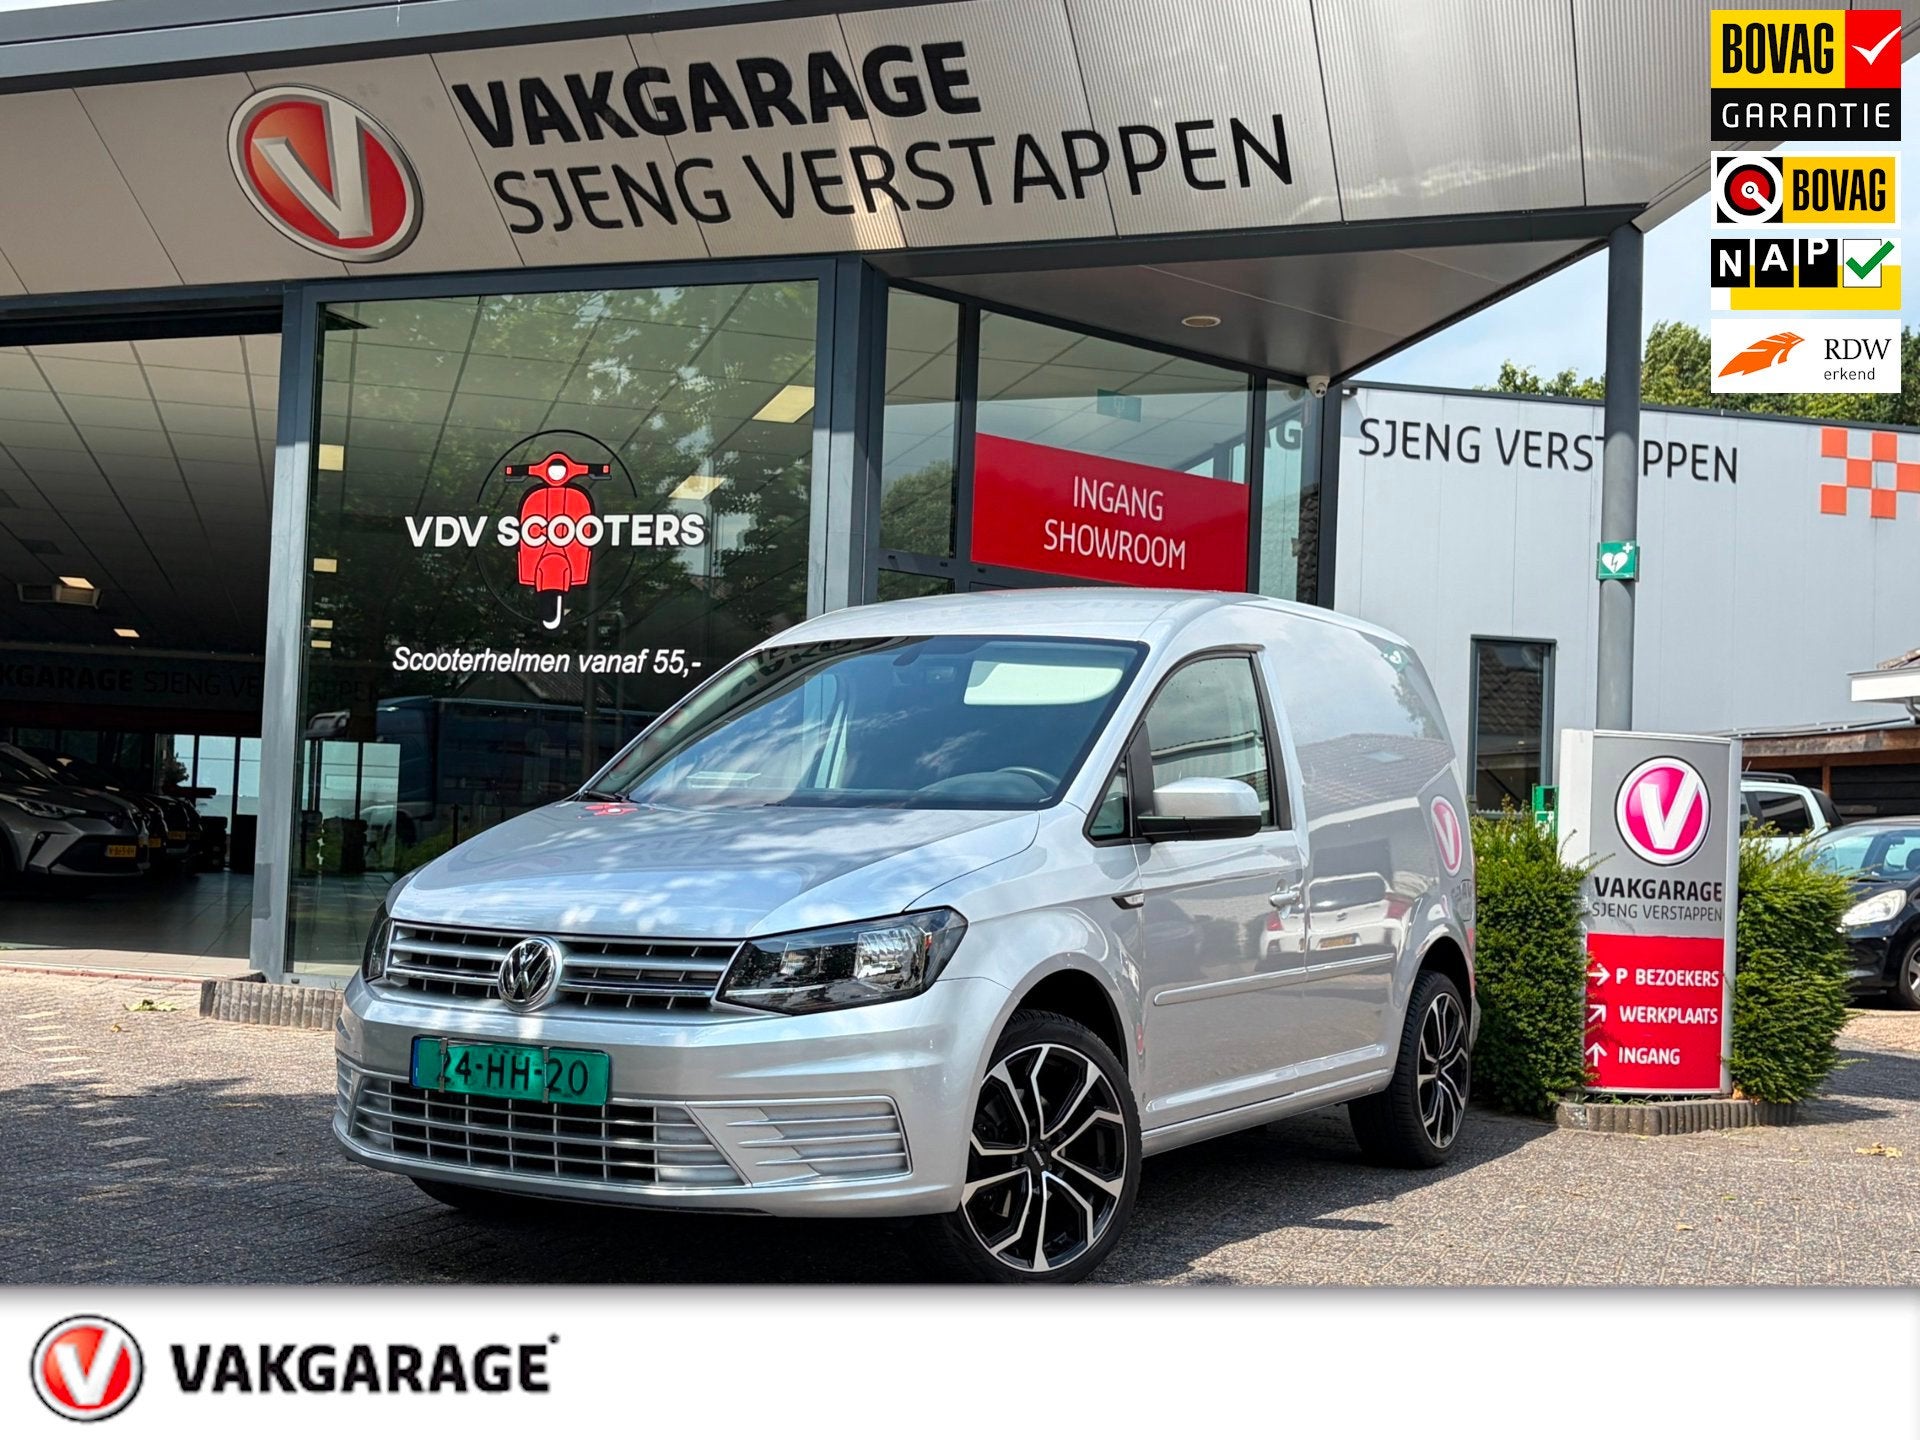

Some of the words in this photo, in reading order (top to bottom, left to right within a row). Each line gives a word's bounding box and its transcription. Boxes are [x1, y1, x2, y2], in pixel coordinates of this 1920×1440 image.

[452, 41, 981, 149] VAKGARAGE
[492, 157, 731, 234] SJENG
[741, 113, 1293, 218] VERSTAPPEN
[1358, 417, 1482, 464] SJENG
[1495, 426, 1738, 484] VERSPPEN
[1073, 475, 1164, 522] INGANG
[404, 515, 489, 548] VDV
[496, 513, 707, 548] SCOOTERS
[1043, 518, 1186, 571] SHOWROOM
[392, 646, 571, 672] Scooterhelmen
[578, 649, 649, 673] vanaf
[652, 649, 702, 678] 55,-
[1593, 876, 1723, 903] VAKGARAGE
[1592, 902, 1638, 919] SJENG
[1643, 904, 1723, 922] VERSTAPPEN
[1615, 966, 1628, 985] P
[1635, 968, 1720, 987] BEZOEKERS
[1619, 1005, 1719, 1025] WERKPLAATS
[1618, 1046, 1681, 1066] INGANG
